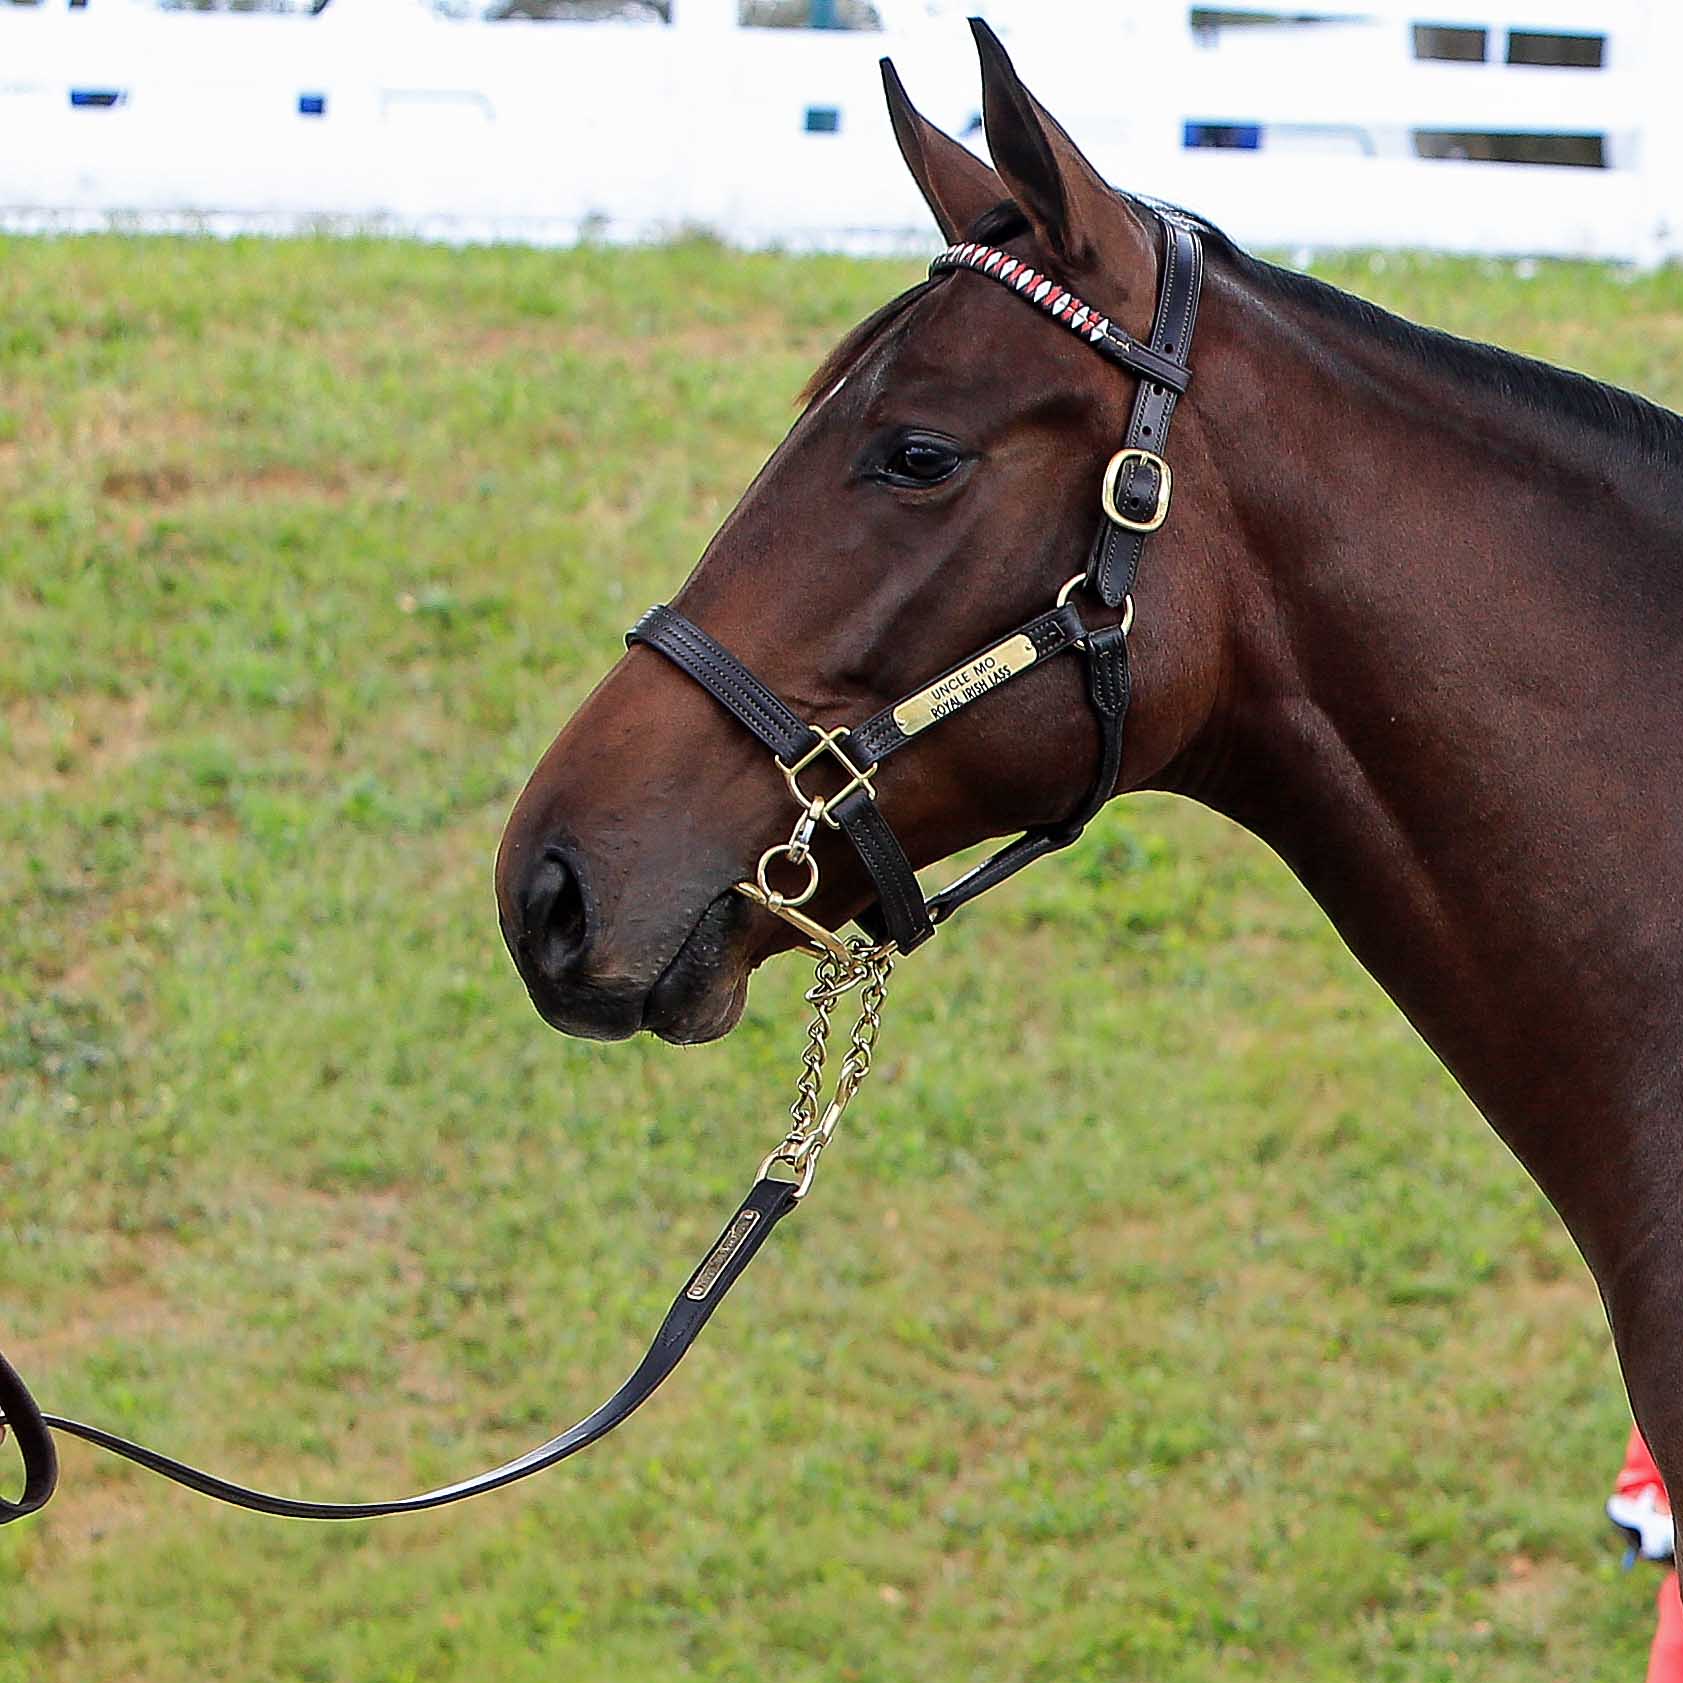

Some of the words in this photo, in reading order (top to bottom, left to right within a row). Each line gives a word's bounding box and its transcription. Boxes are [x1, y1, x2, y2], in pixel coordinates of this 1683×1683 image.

[930, 696, 963, 719] ROYAL
[962, 678, 987, 701] IRISH
[931, 671, 971, 700] UNCLE
[973, 657, 996, 676] MO
